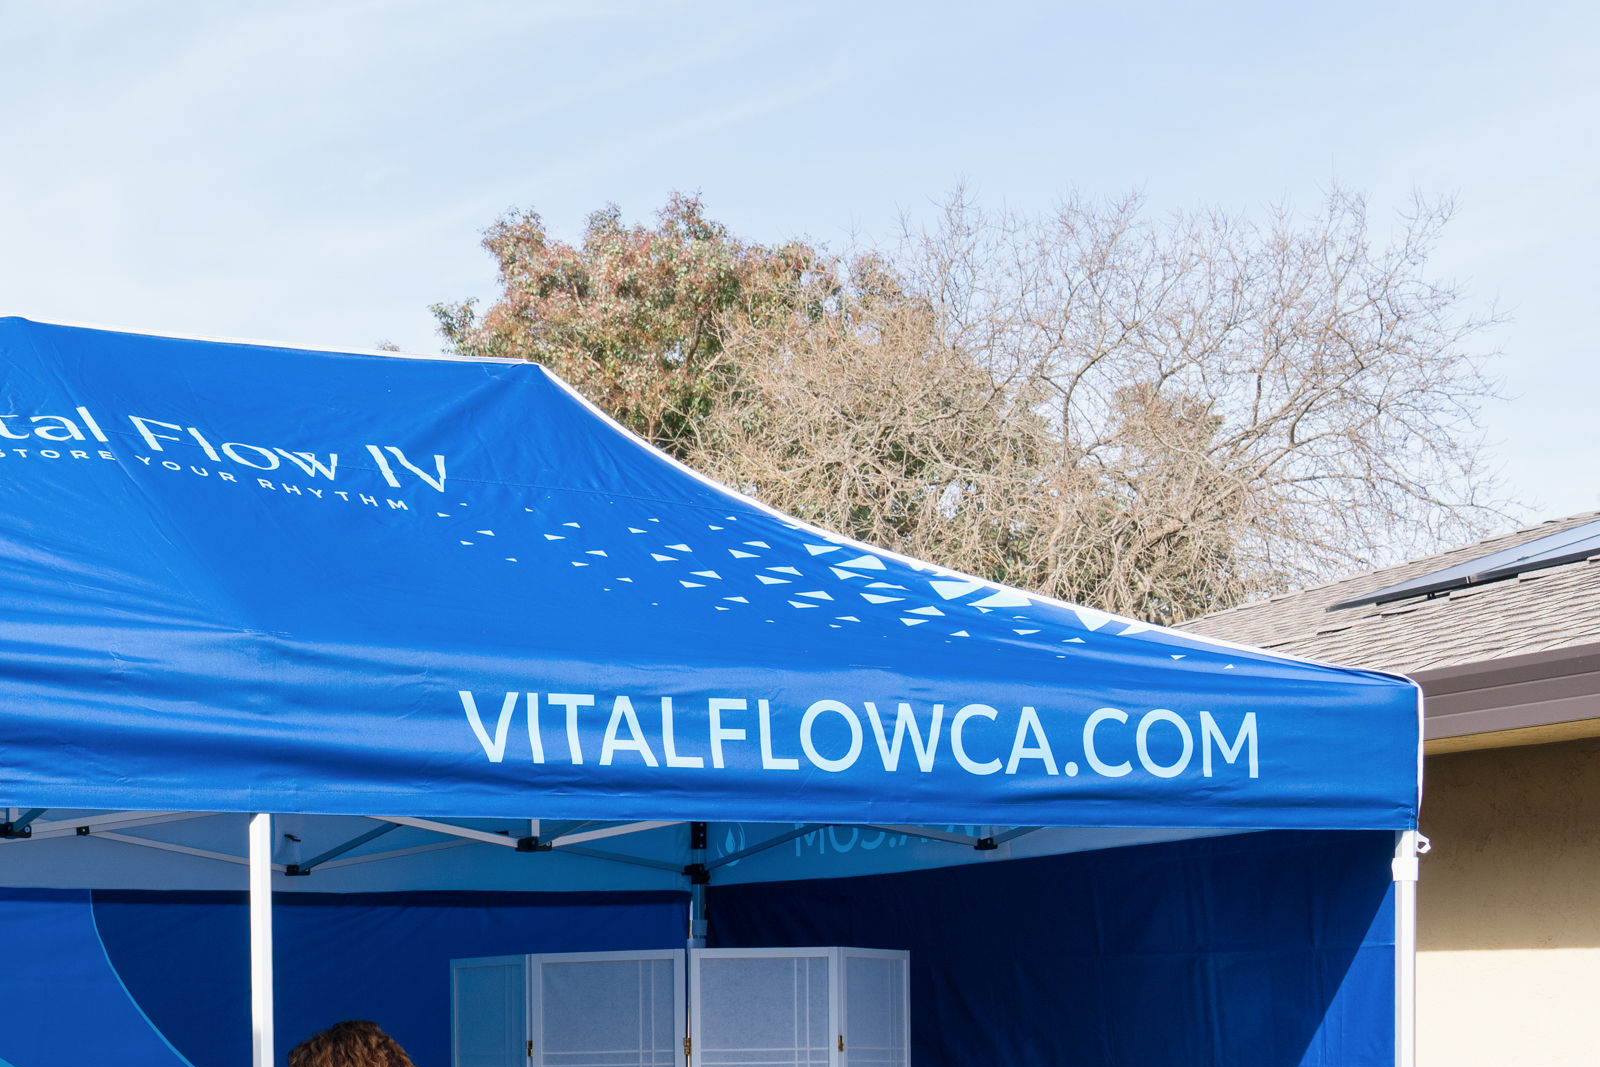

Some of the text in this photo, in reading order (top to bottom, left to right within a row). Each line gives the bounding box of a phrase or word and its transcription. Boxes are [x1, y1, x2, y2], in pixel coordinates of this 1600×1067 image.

[128, 415, 338, 481] Flow
[365, 444, 447, 493] IV
[134, 454, 238, 483] YOUR
[256, 478, 409, 511] RHYTHM
[458, 690, 1259, 779] VITALFLOWCA.COM
